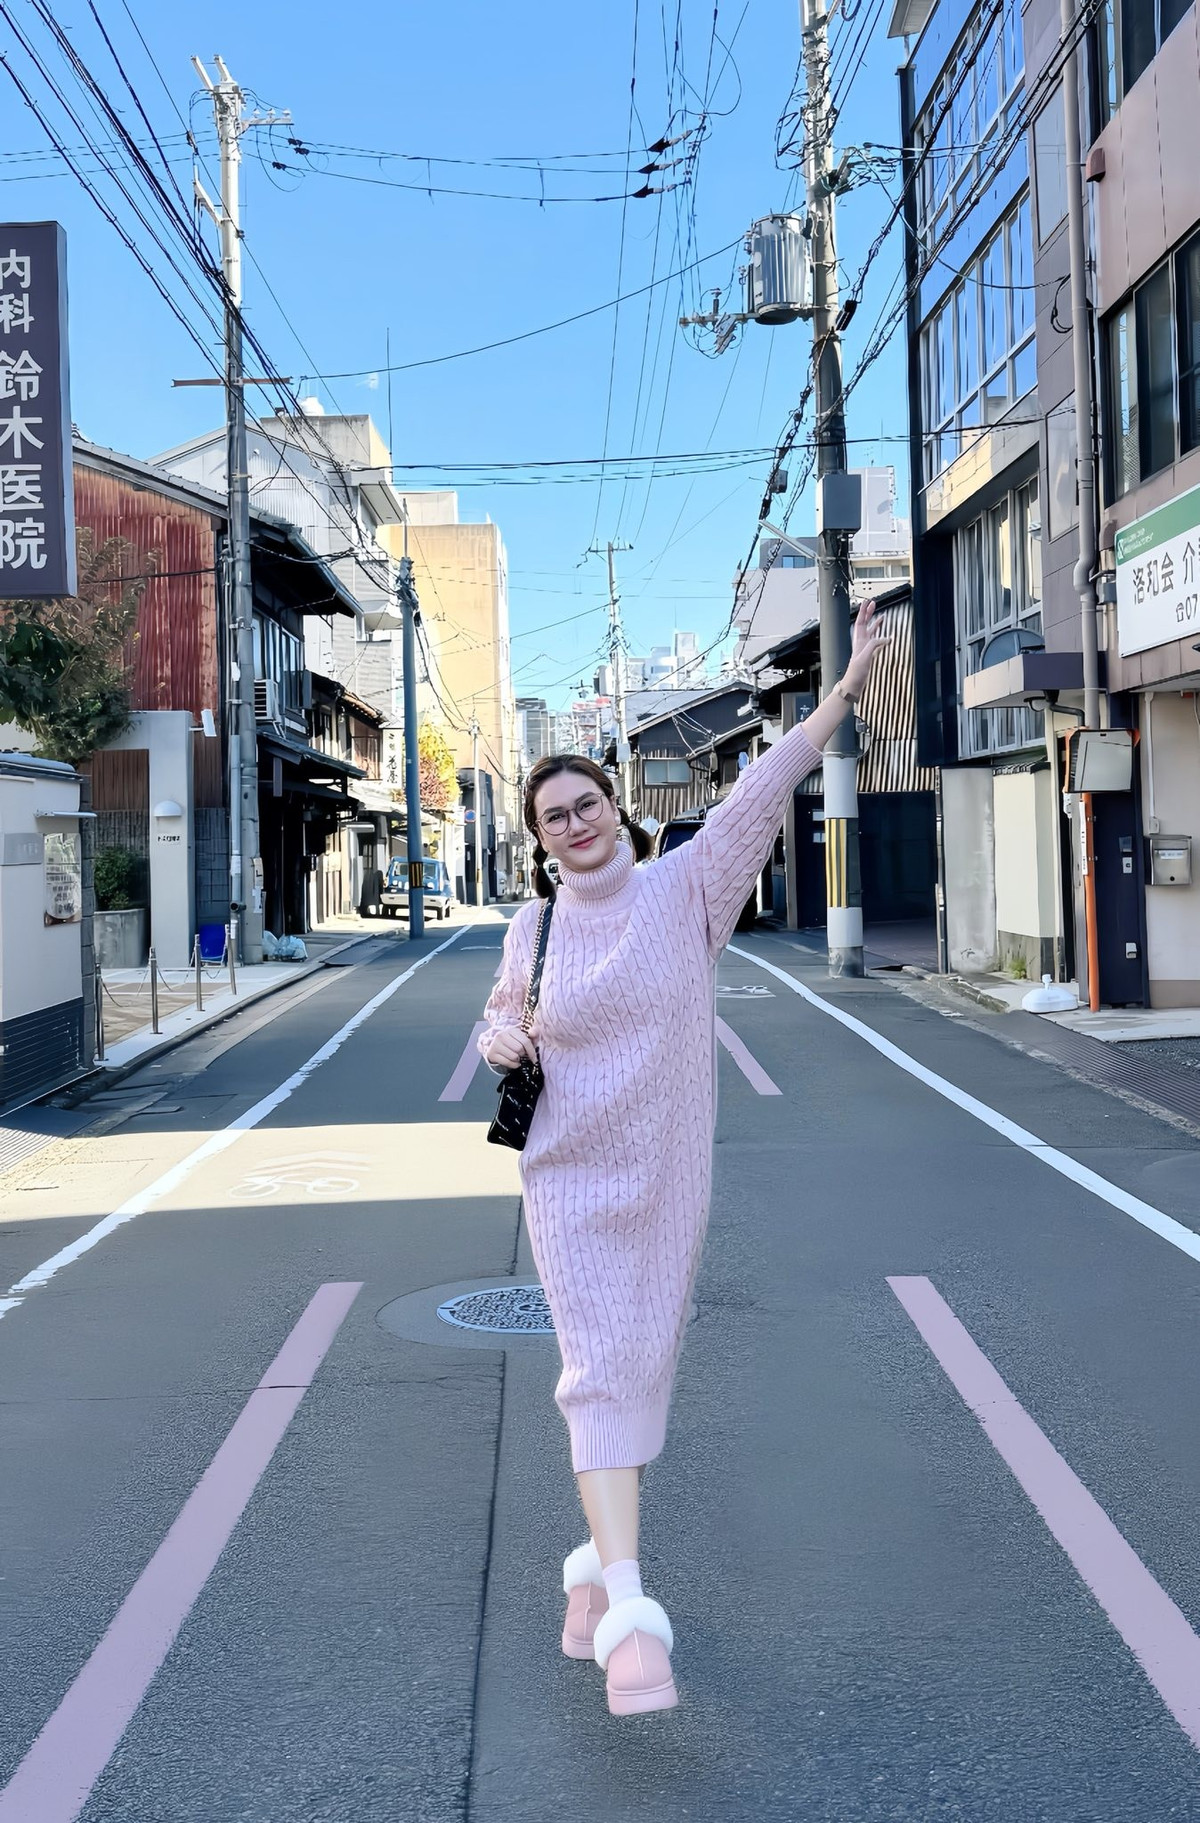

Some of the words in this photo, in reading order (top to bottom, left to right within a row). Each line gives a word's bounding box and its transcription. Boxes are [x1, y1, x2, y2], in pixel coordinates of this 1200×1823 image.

[0, 248, 35, 334] 内科
[0, 350, 47, 569] 鈴木医院
